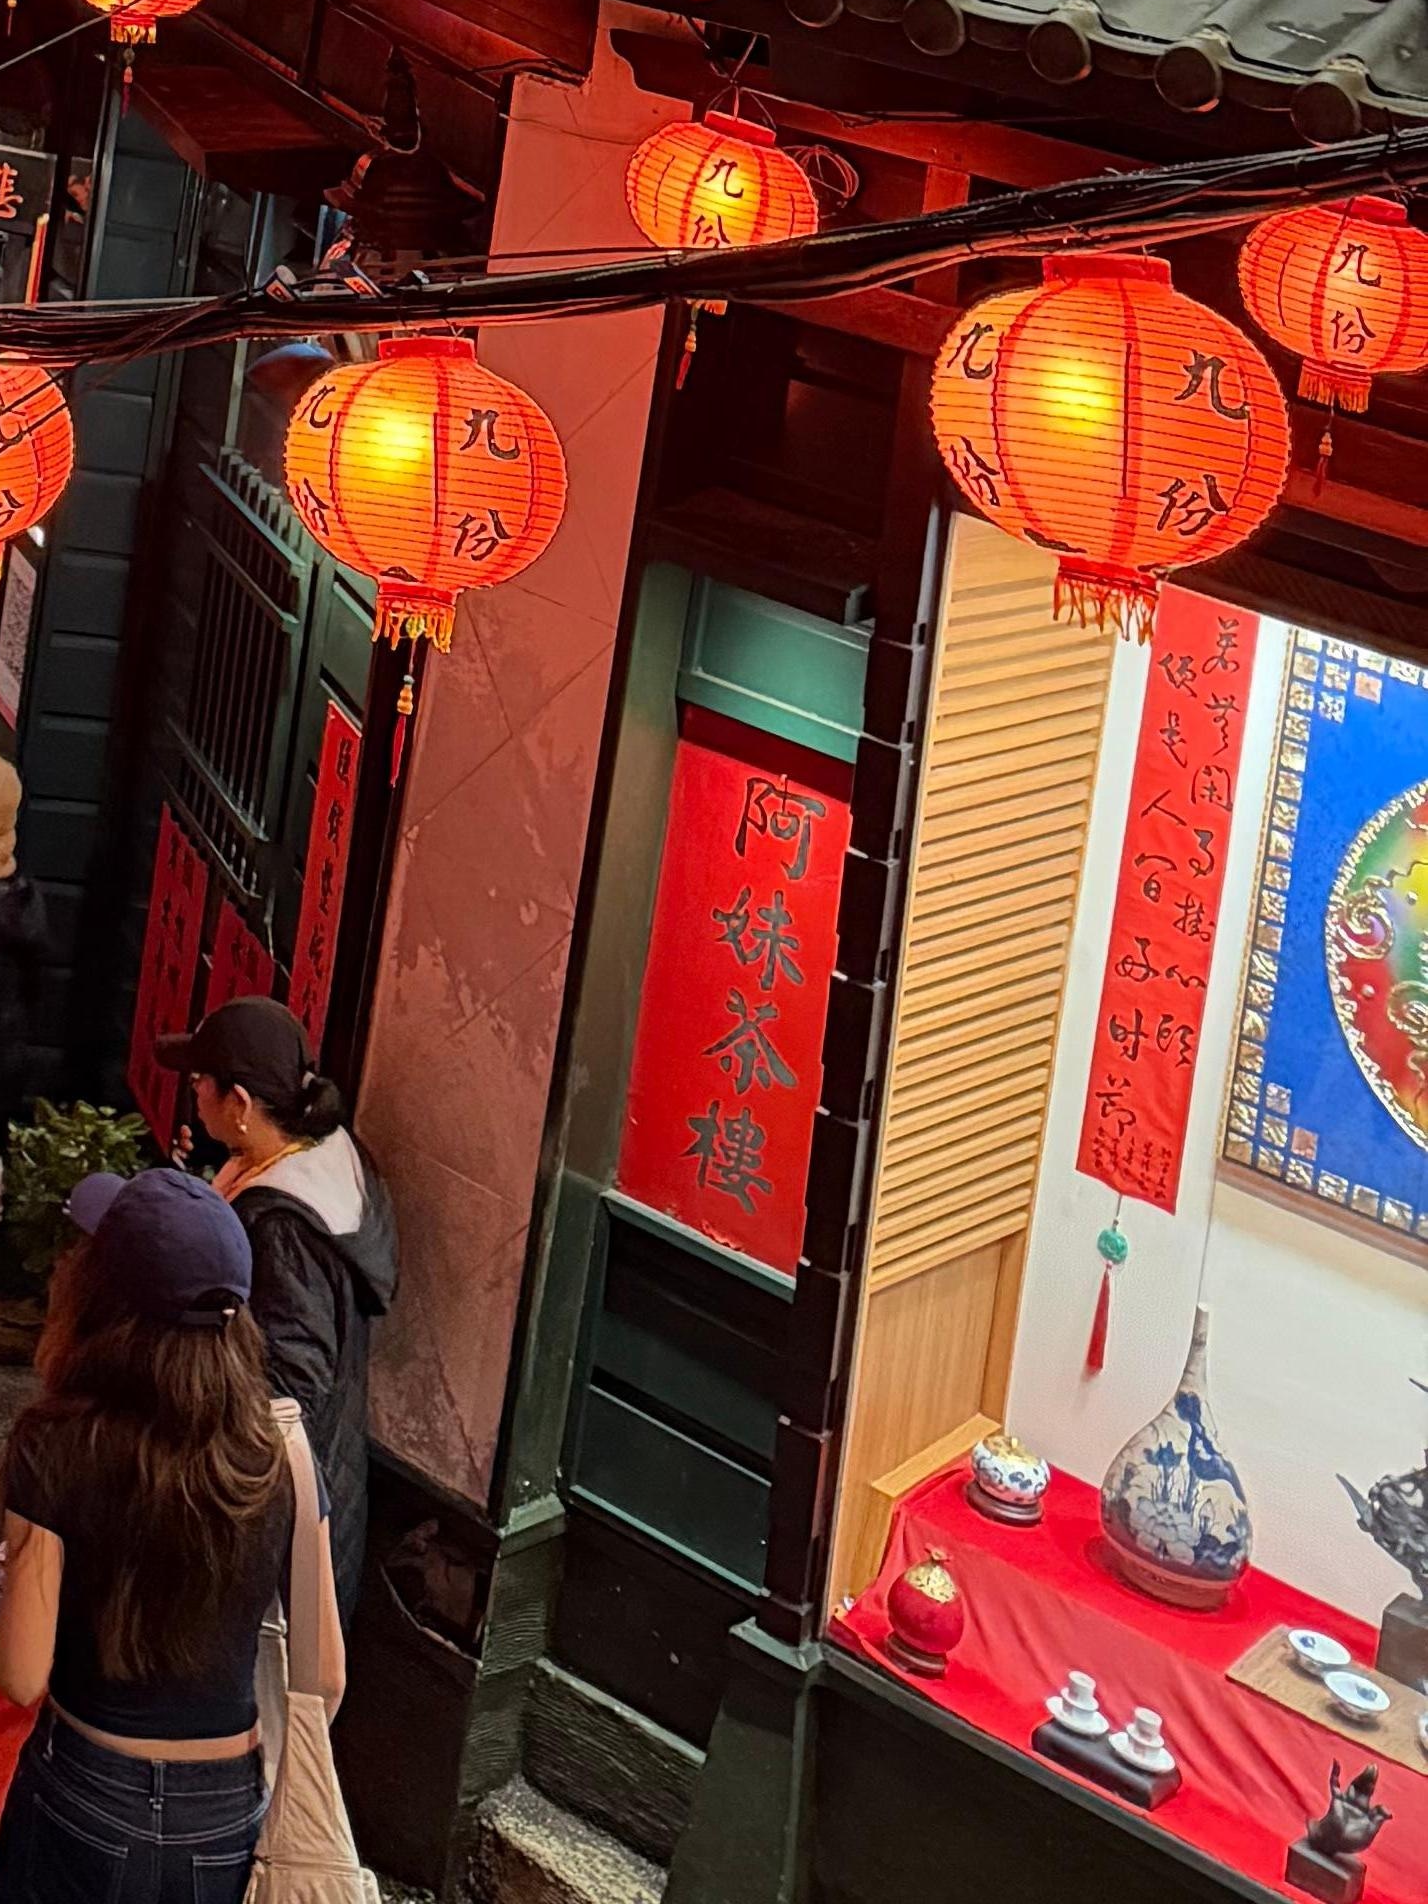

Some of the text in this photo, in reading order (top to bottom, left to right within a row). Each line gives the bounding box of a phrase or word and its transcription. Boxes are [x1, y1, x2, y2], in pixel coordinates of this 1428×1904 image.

[1330, 241, 1382, 355] 九份
[453, 407, 521, 562] 九份
[1158, 348, 1251, 537] 九份
[688, 775, 827, 1214] 阿妹茶樓
